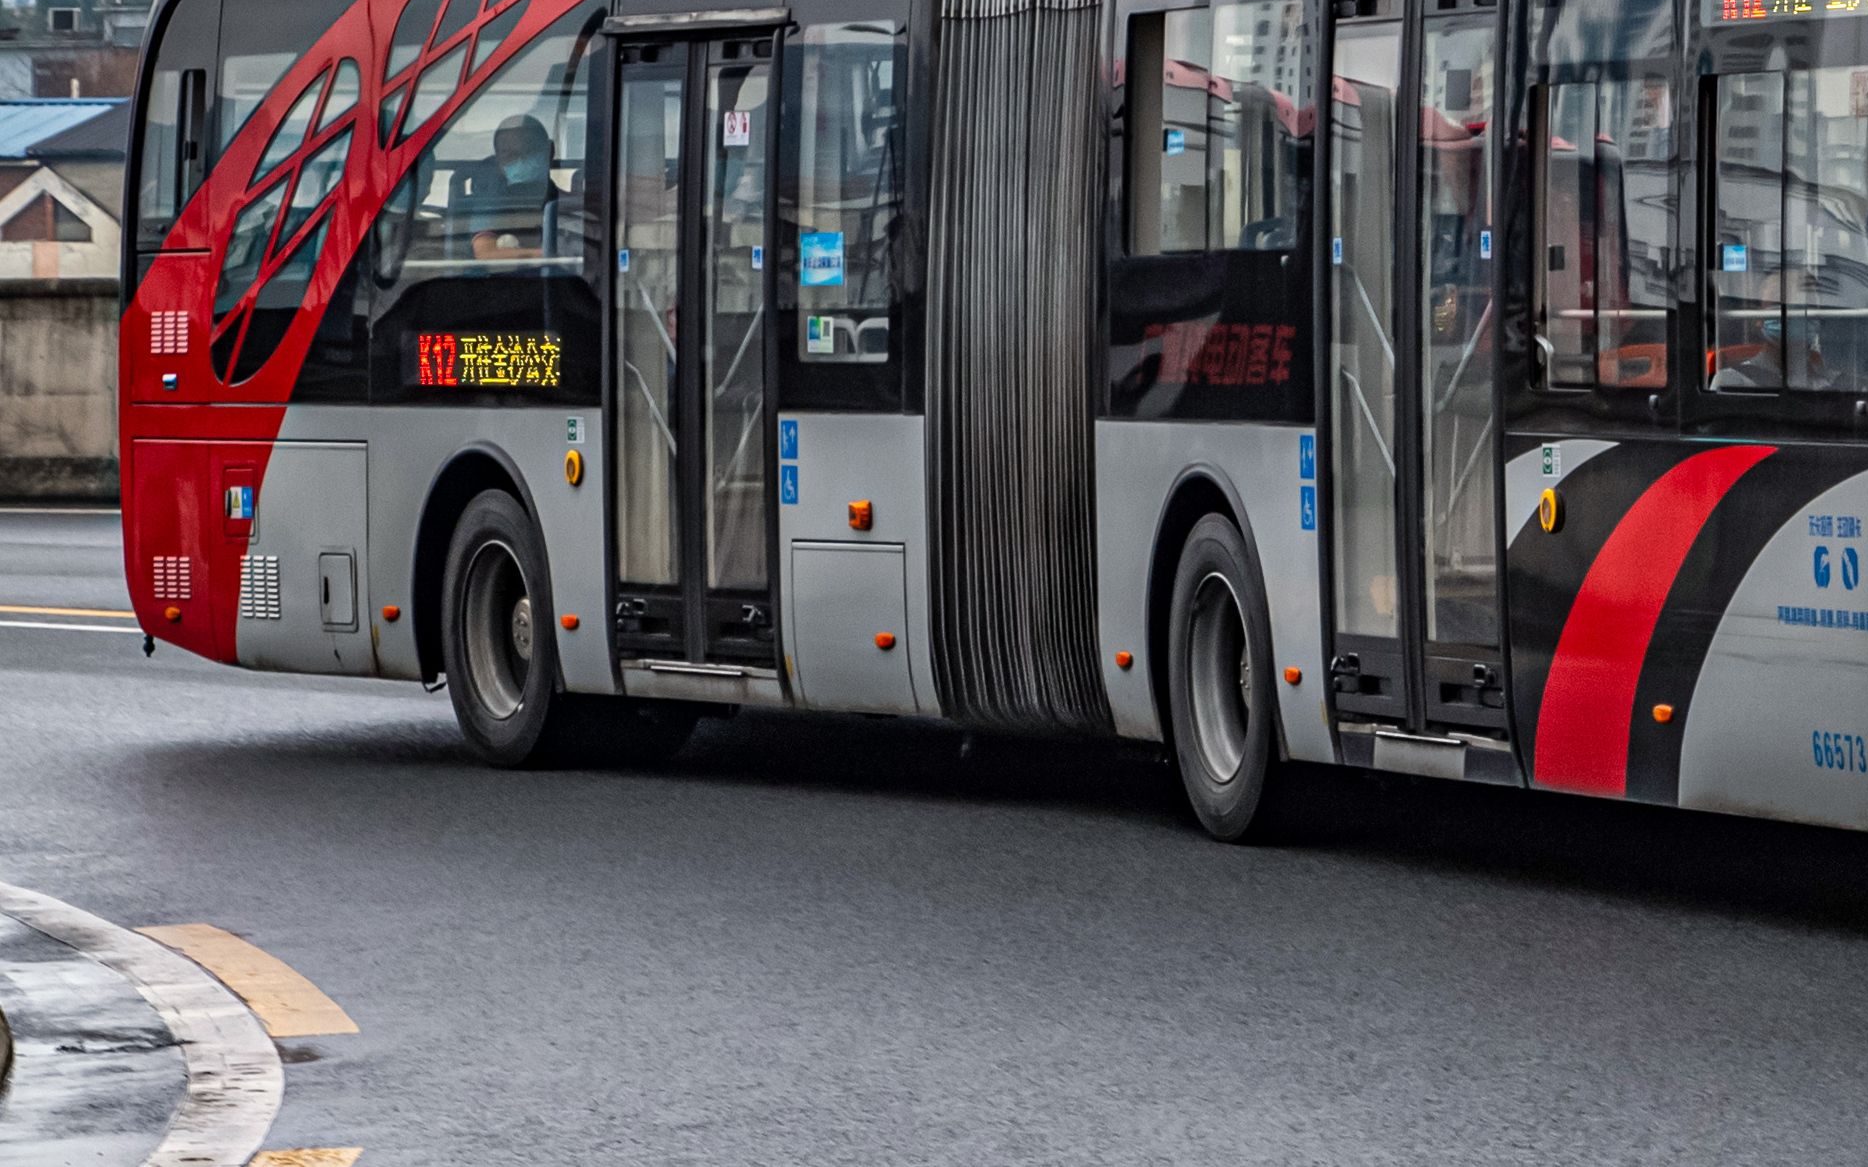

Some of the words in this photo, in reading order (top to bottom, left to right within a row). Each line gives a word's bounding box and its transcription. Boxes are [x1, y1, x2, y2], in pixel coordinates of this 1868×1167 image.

[418, 335, 457, 386] K12
[459, 335, 561, 386] 开往金沙公交
[1812, 730, 1867, 773] 66573
